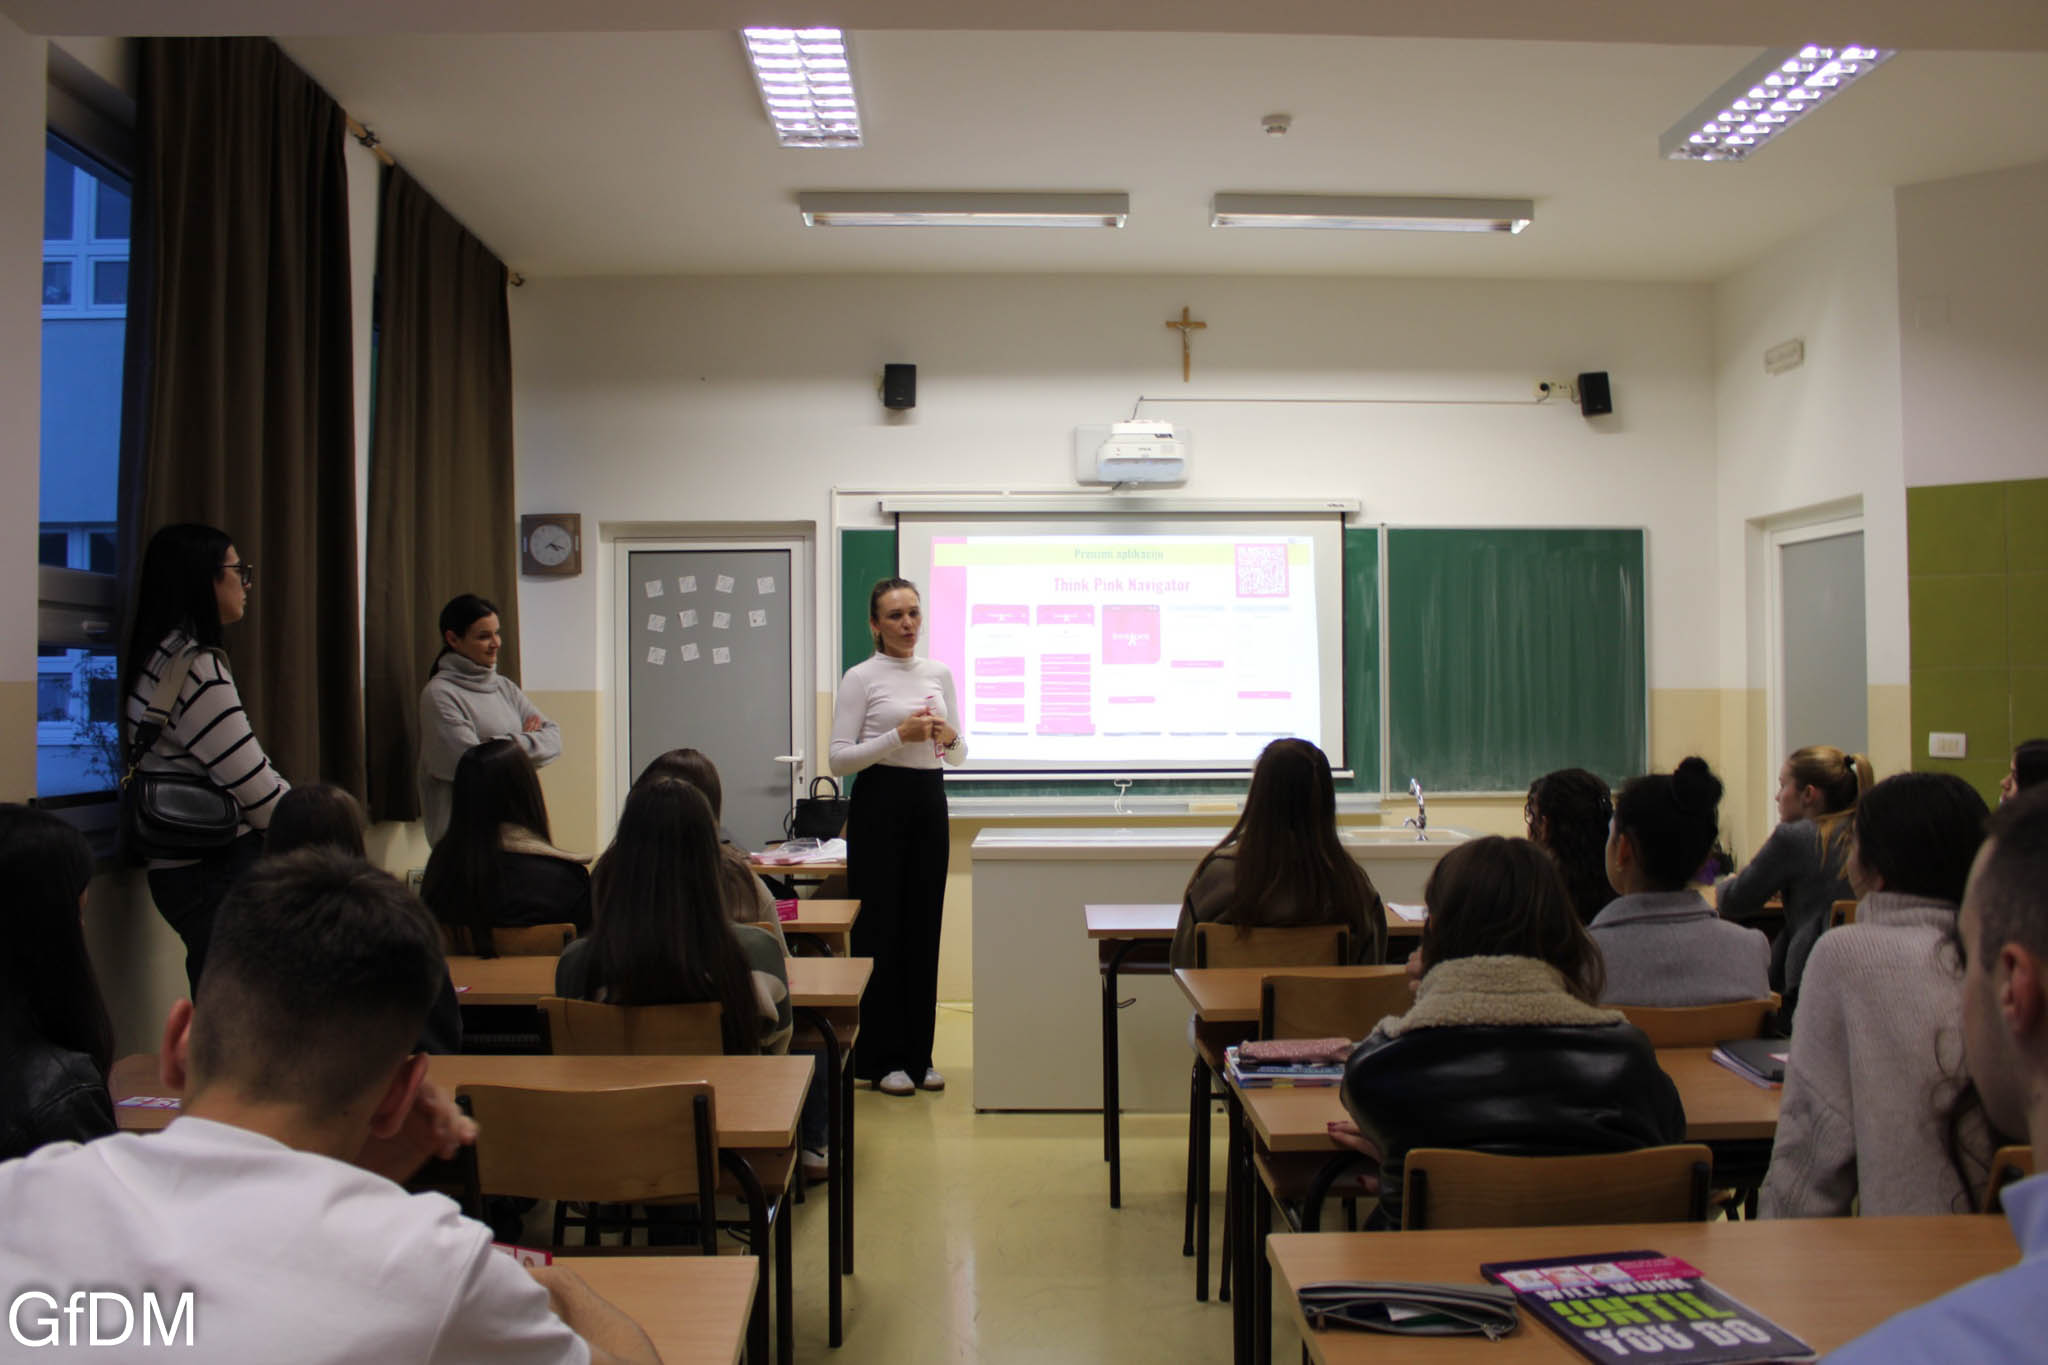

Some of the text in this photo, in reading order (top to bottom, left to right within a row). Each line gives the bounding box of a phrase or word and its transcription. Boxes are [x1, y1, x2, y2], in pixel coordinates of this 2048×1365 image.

[1054, 577, 1191, 595] Think Pink Navigator
[1550, 1292, 1737, 1328] UNTIL
[1584, 1319, 1771, 1355] YOU DO
